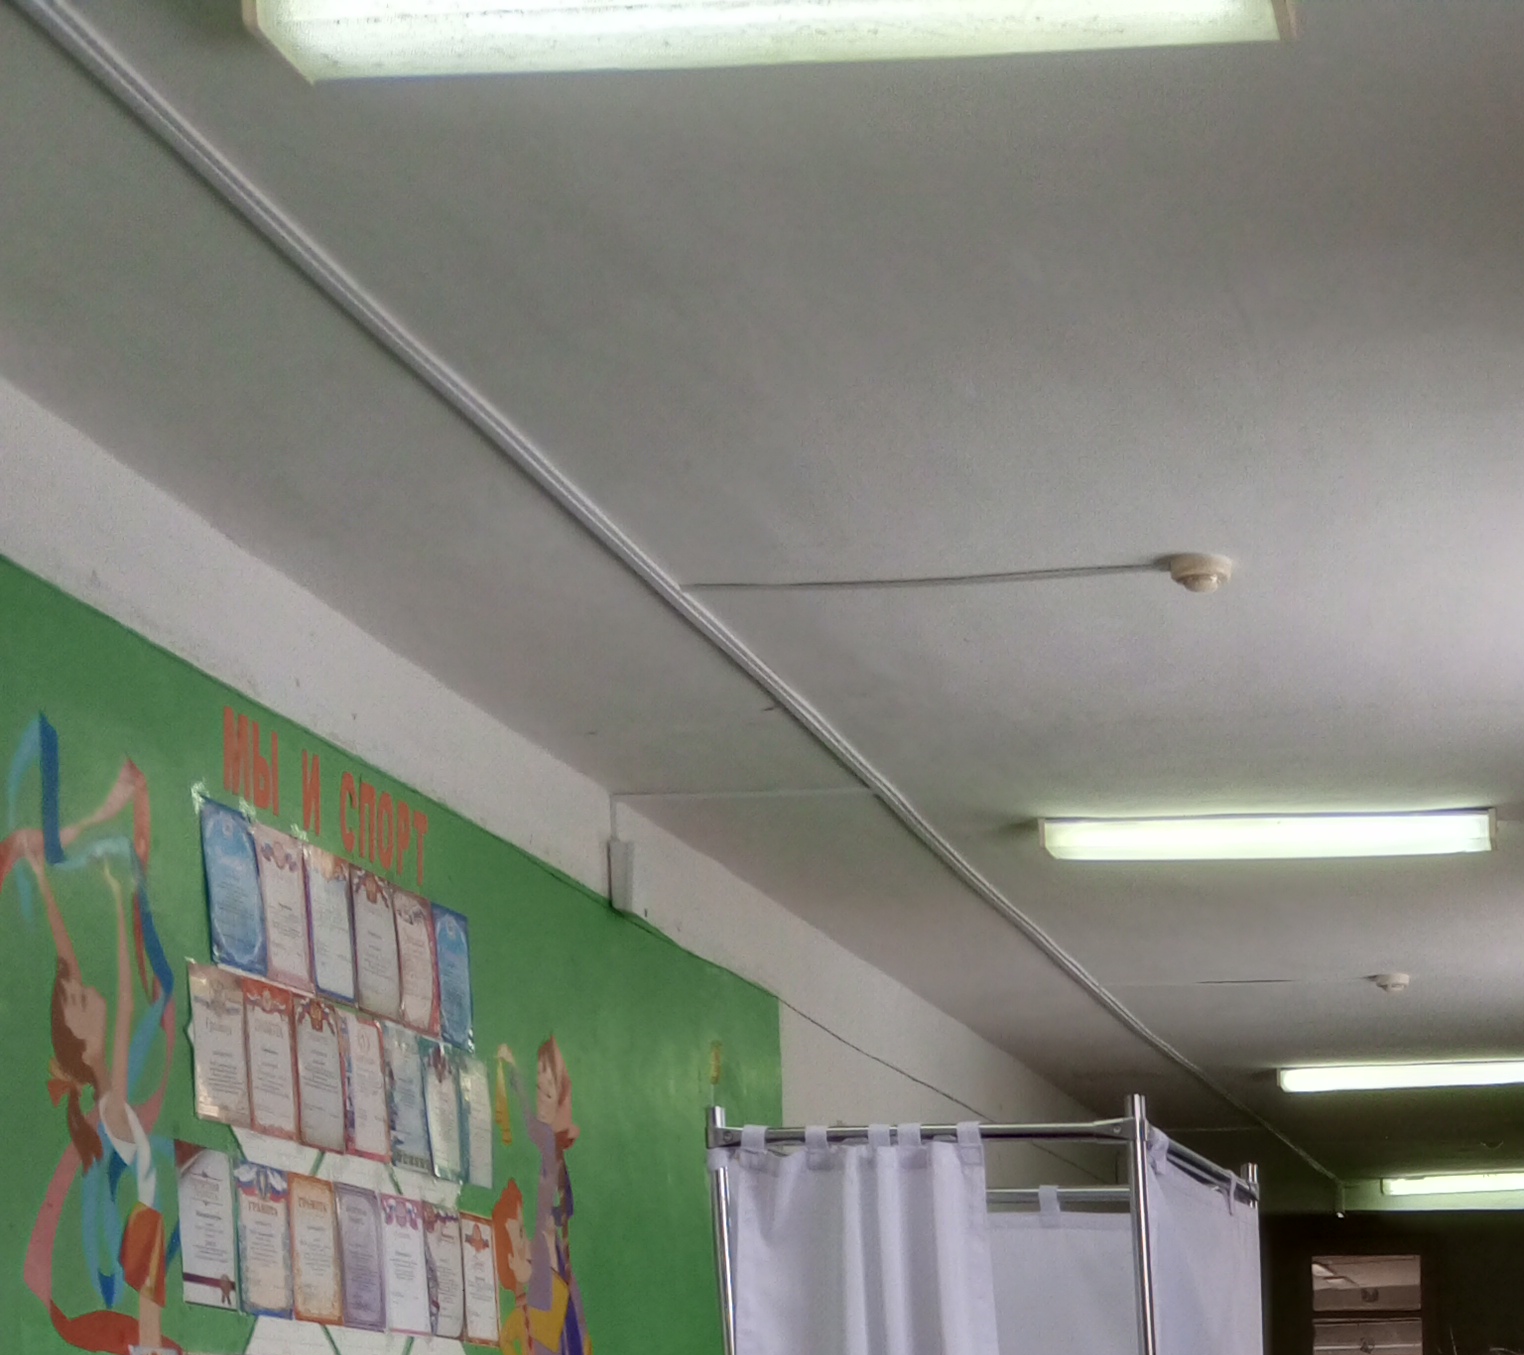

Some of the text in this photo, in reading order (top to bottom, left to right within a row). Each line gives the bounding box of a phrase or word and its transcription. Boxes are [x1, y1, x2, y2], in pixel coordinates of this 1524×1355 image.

[223, 706, 429, 887] МЫ И СПОРТ
